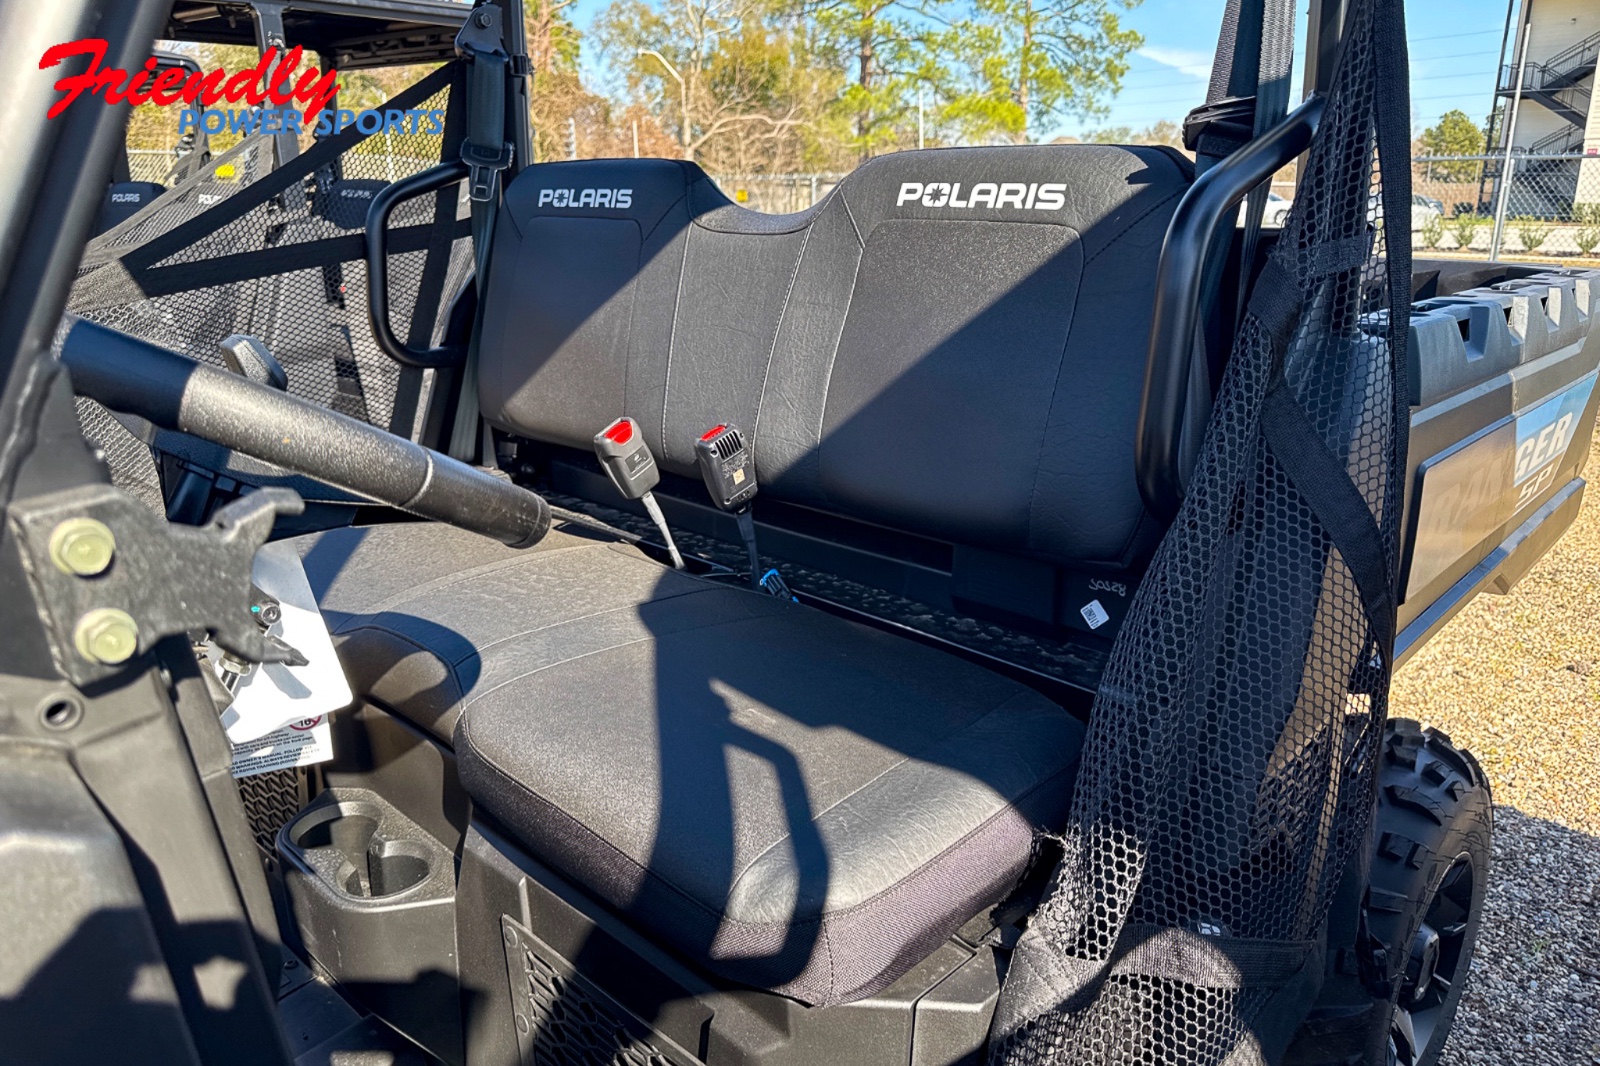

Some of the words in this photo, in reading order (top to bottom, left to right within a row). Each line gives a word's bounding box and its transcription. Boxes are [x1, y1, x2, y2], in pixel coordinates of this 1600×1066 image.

[111, 193, 140, 203] POLARIS
[538, 188, 633, 209] POLARIS
[896, 182, 1068, 211] POLARIS
